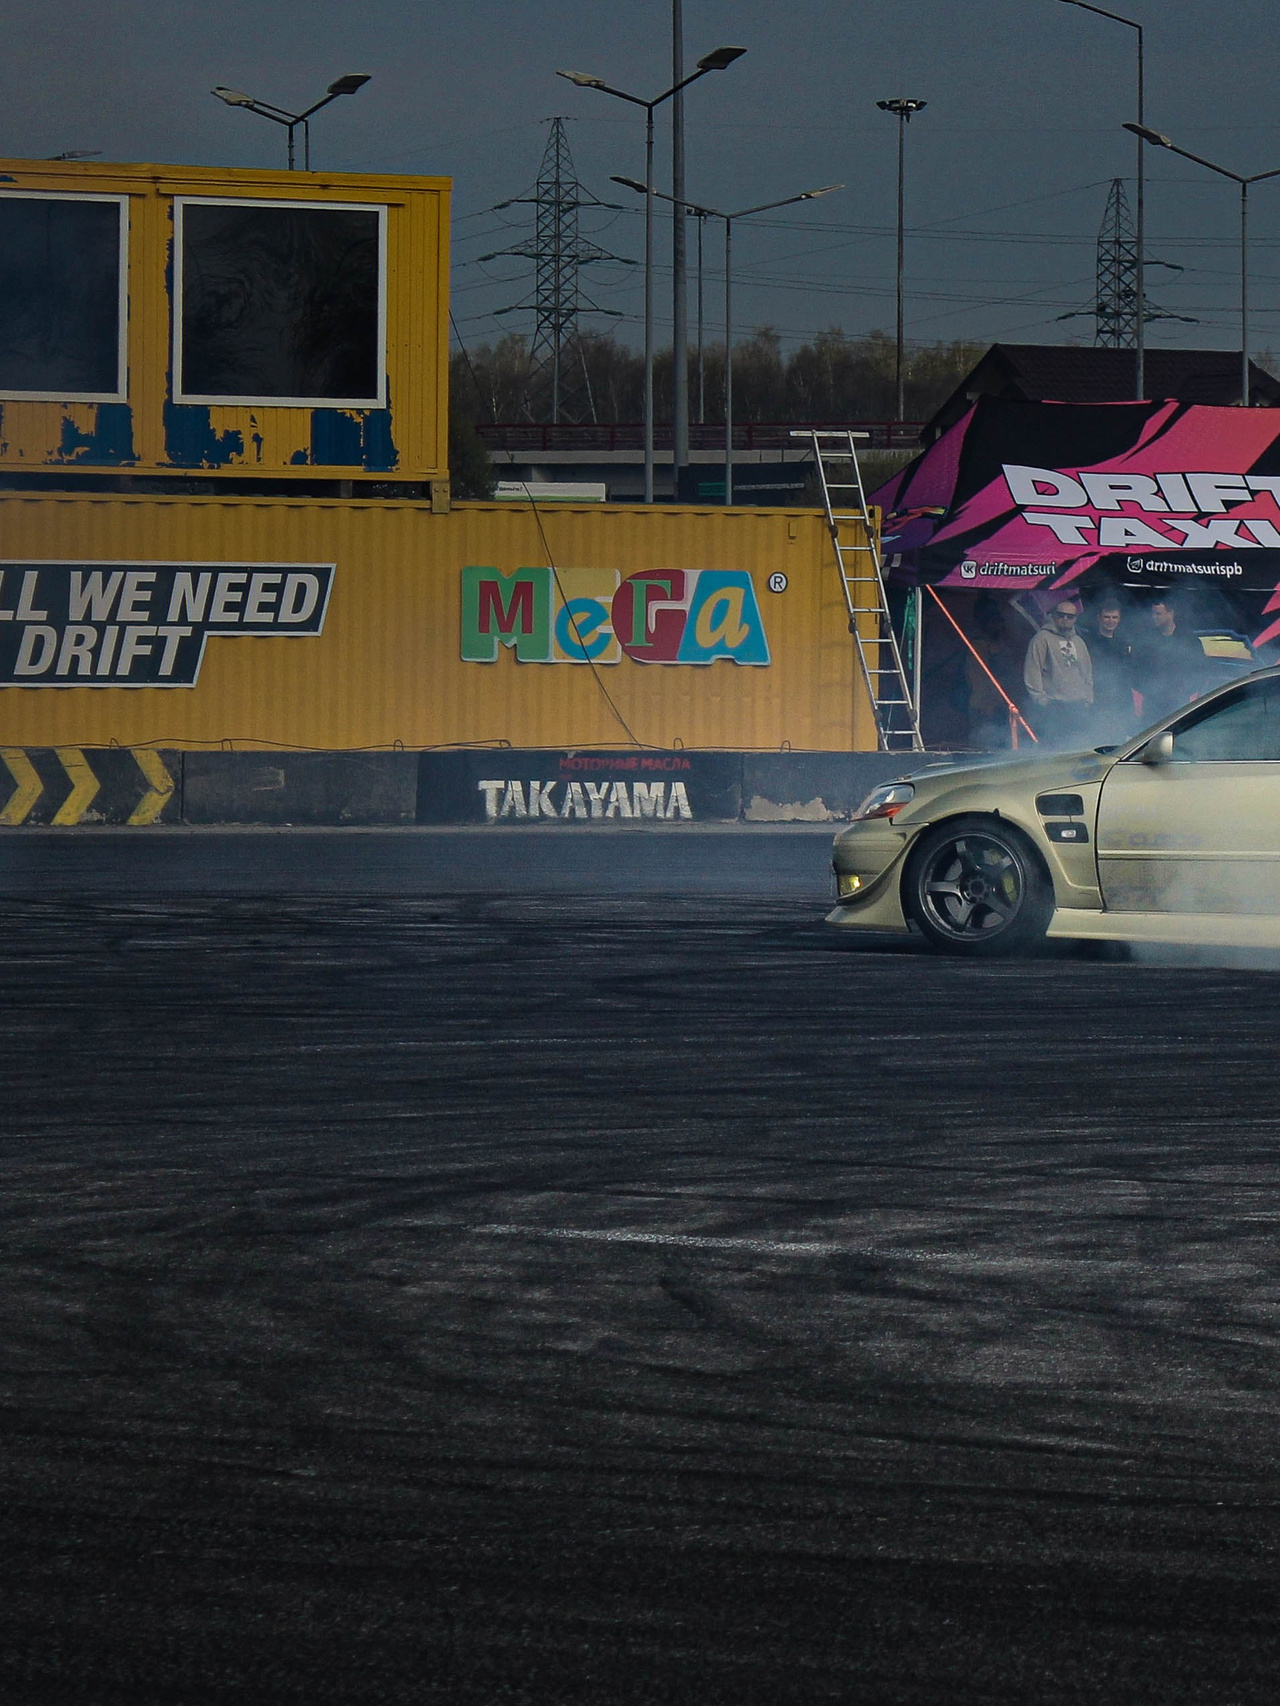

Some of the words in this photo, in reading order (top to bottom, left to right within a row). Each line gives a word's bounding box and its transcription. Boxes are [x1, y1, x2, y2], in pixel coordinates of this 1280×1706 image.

[979, 561, 1056, 575] driftmatsuri
[69, 570, 157, 621] WE
[166, 572, 320, 623] NEED
[13, 625, 194, 676] DRIFT
[559, 757, 638, 771] МОТОРНЫЕ
[641, 757, 691, 771] МАСЛА
[478, 780, 693, 820] TAKAYAMA
